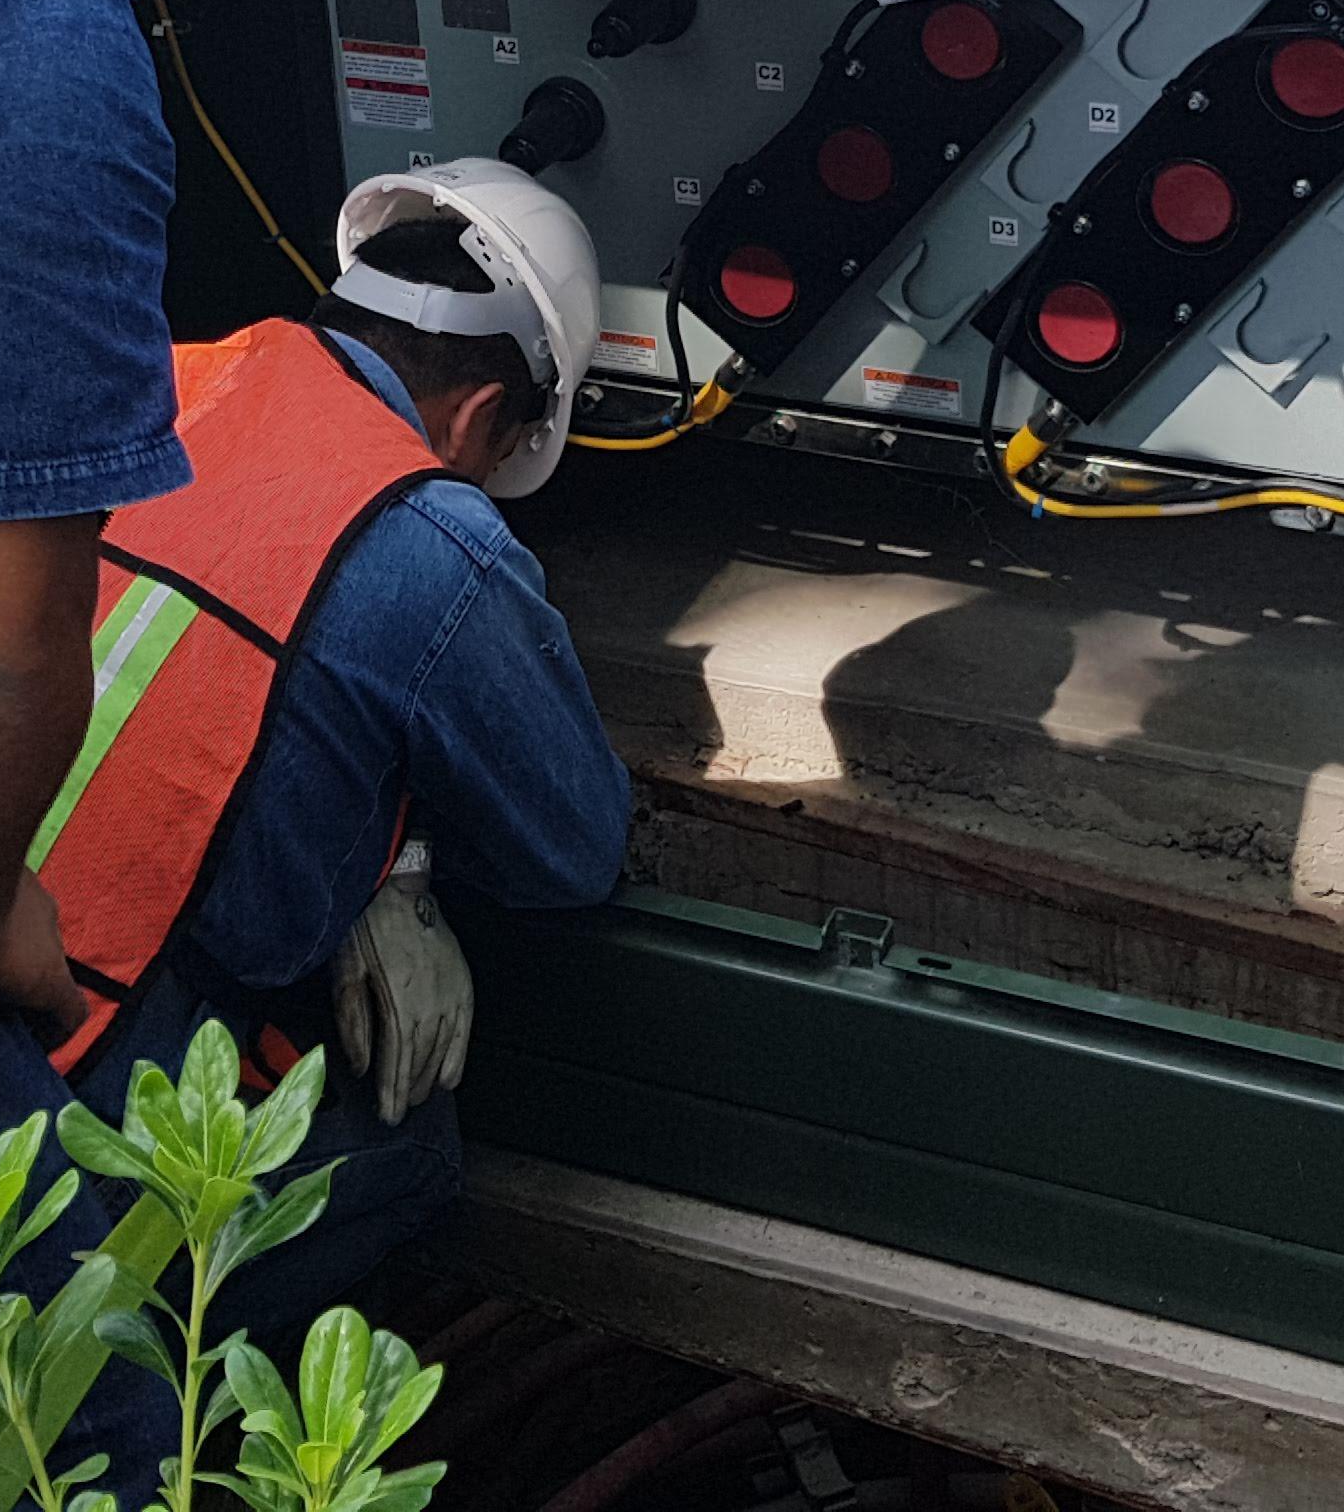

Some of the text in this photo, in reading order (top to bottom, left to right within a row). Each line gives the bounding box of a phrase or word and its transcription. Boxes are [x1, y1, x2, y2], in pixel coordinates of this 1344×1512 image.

[495, 40, 517, 55] A2
[758, 65, 780, 81] C2
[1091, 107, 1115, 123] D2
[676, 180, 698, 195] C3
[991, 220, 1014, 237] D3
